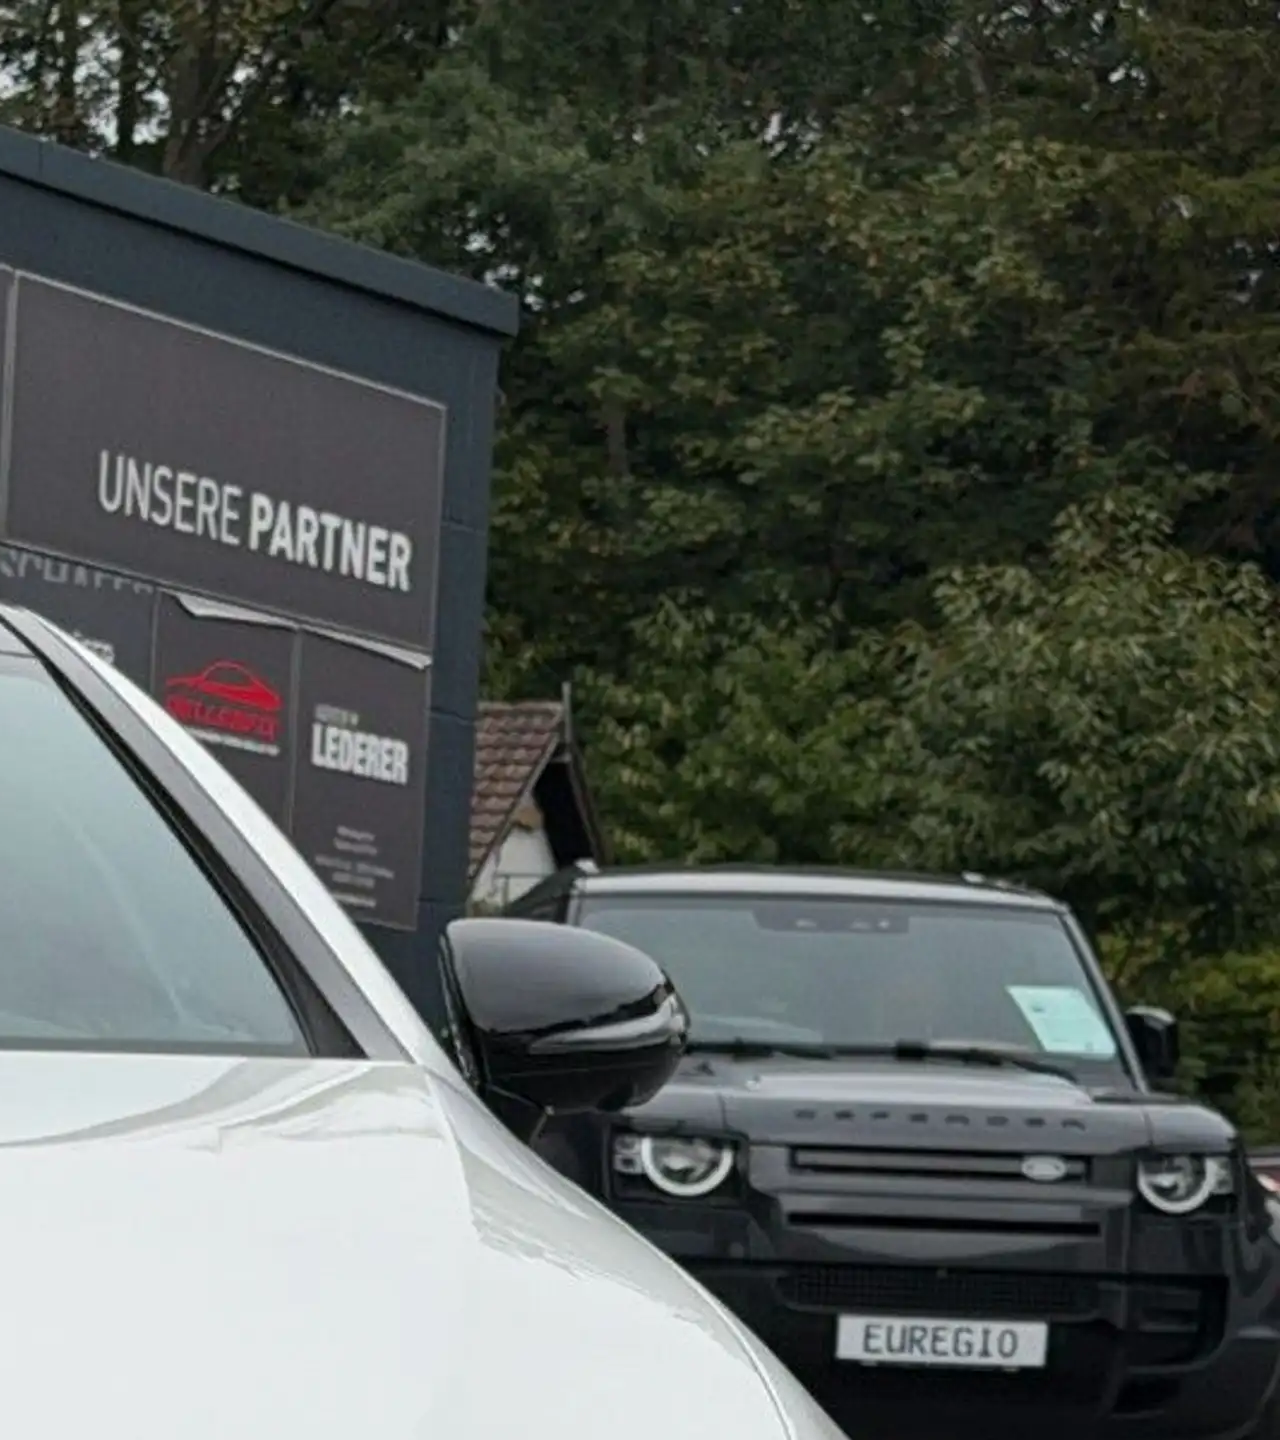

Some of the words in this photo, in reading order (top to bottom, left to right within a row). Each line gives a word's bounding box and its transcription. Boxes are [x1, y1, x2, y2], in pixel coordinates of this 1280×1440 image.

[98, 450, 242, 546] UNSERE
[248, 492, 413, 592] PARTNER
[311, 722, 409, 786] LEDERER
[862, 1323, 1019, 1359] EUREGIO
